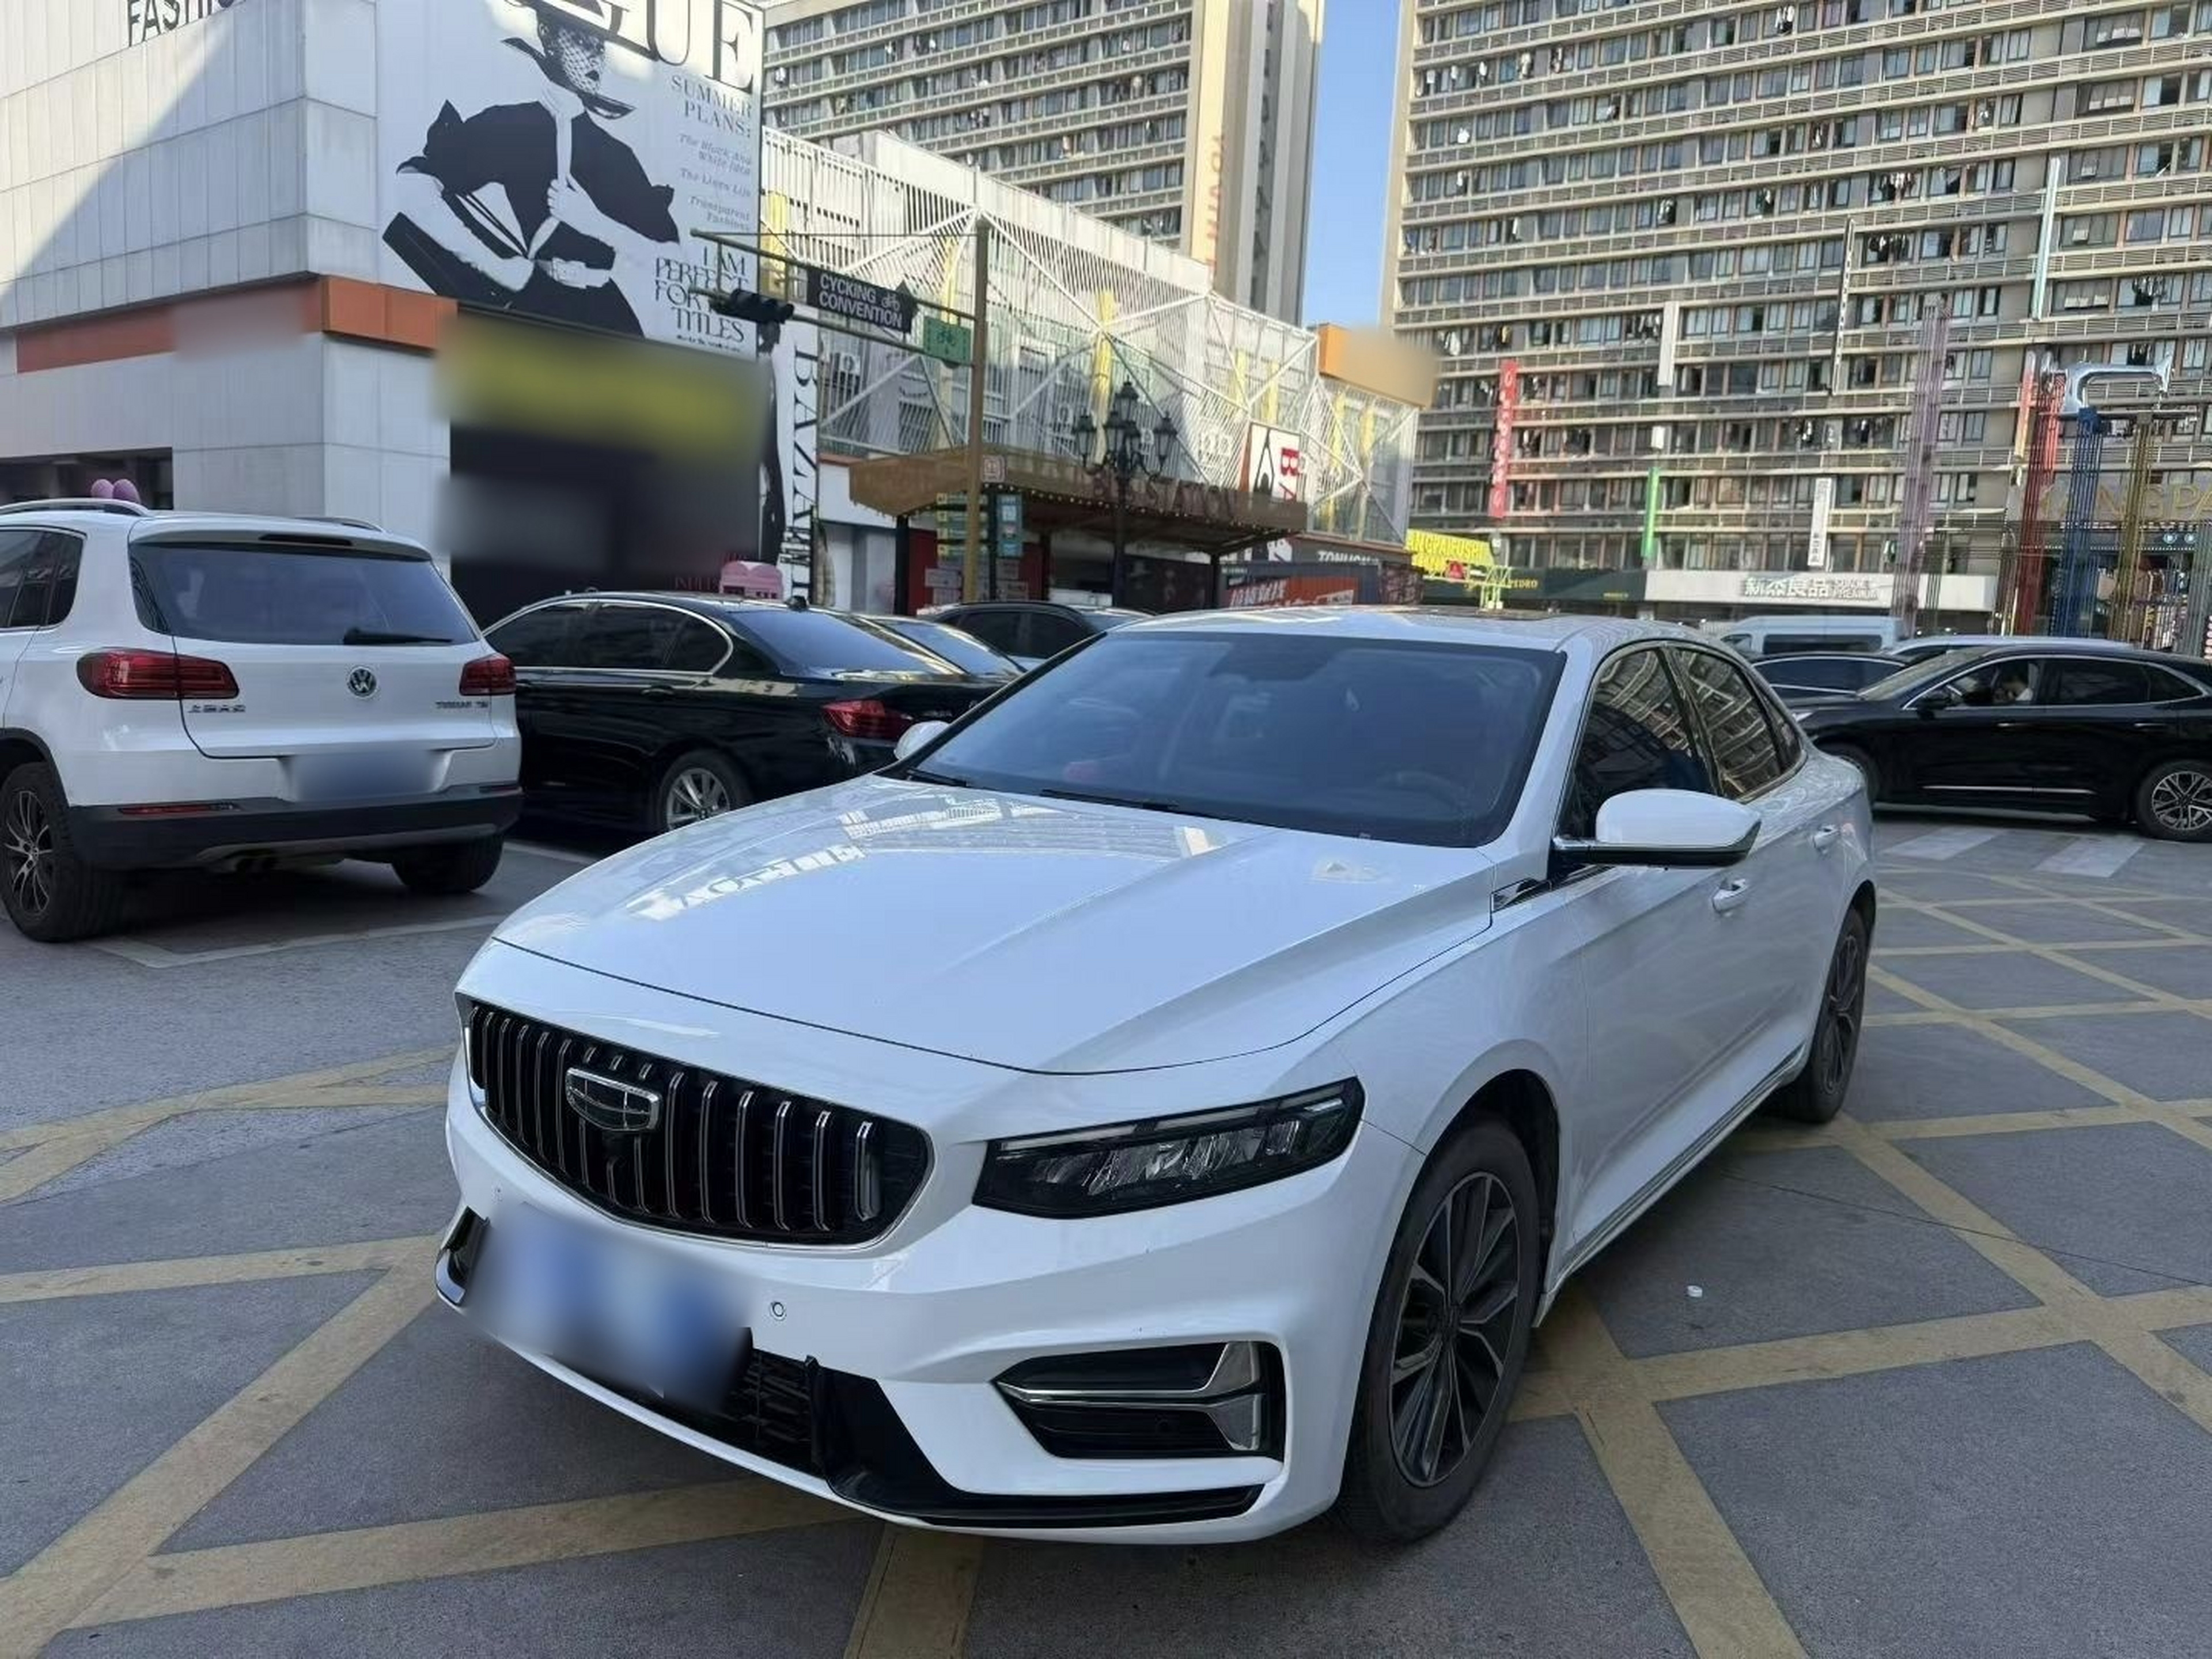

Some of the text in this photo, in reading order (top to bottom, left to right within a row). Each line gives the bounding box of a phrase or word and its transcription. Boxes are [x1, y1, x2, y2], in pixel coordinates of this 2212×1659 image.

[672, 74, 751, 118] SUMMER
[820, 274, 877, 304] CYCKING
[671, 306, 744, 343] TITLES
[819, 291, 902, 328] CONVENTION
